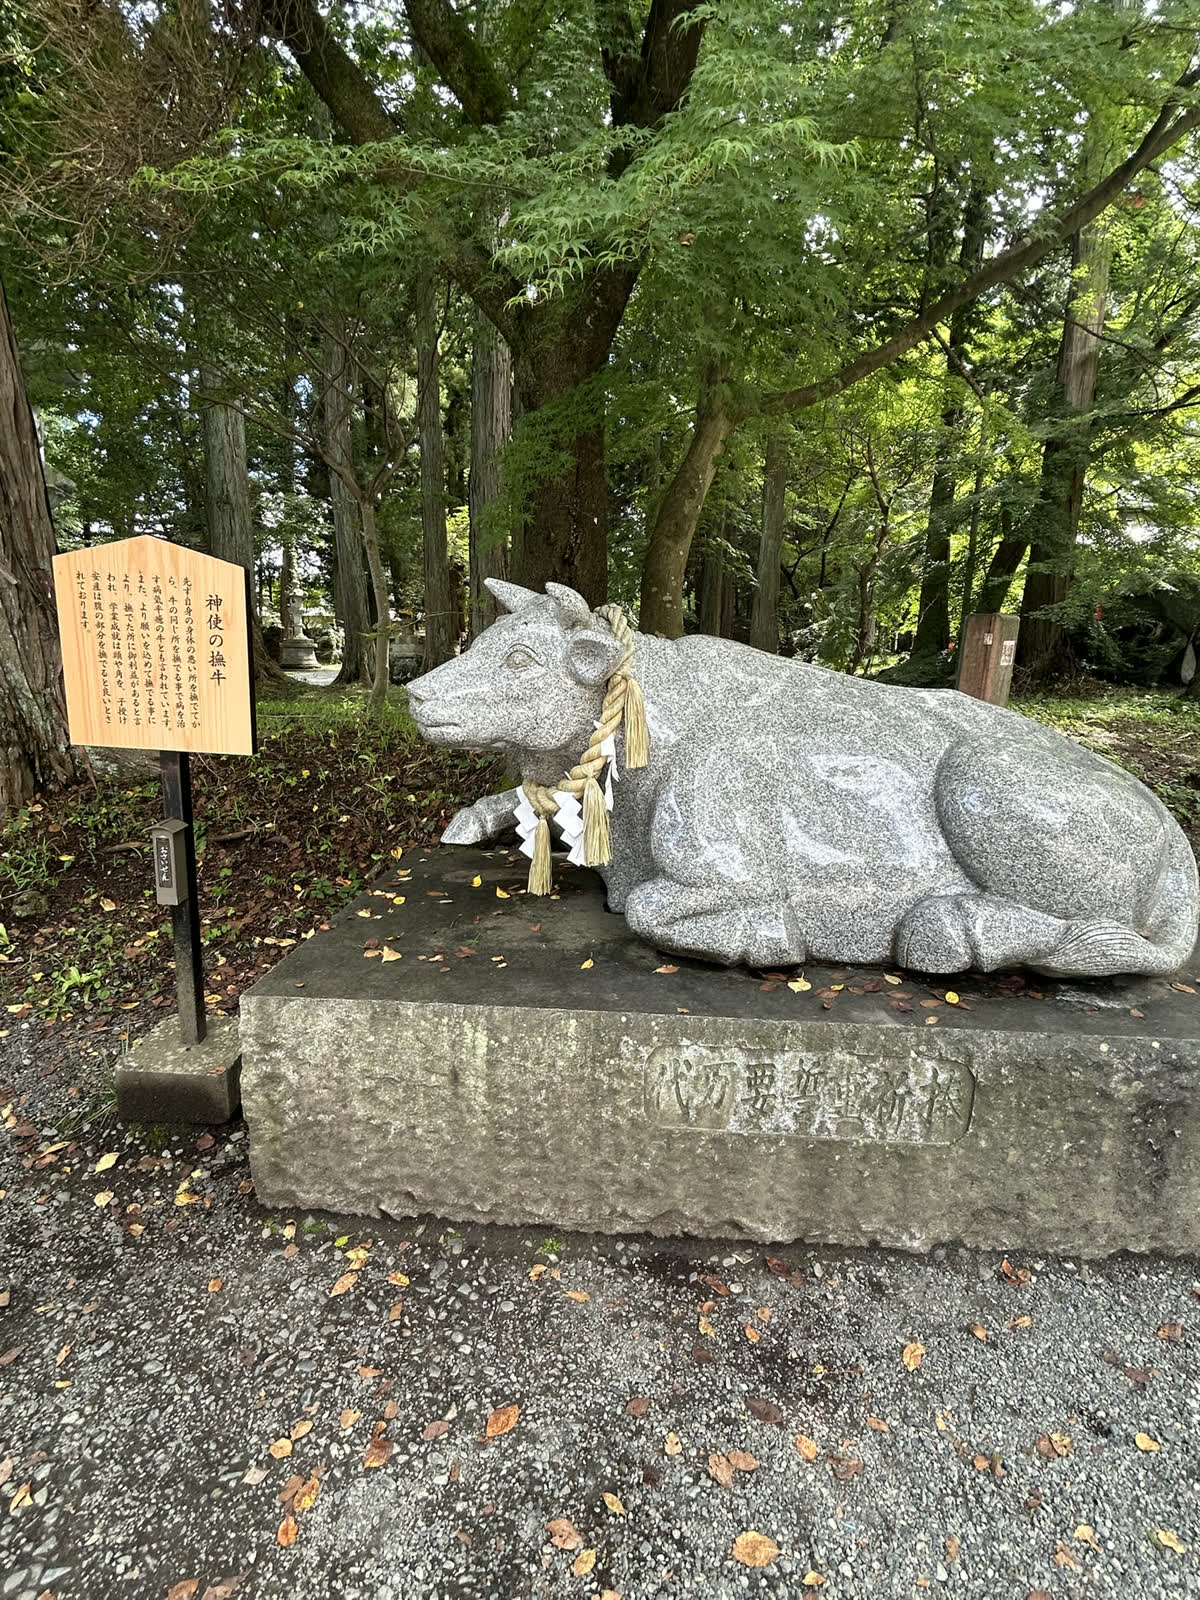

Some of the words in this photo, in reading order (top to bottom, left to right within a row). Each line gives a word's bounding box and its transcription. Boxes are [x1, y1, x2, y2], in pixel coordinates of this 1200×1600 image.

[76, 571, 91, 633] れております。
[205, 595, 227, 686] 神使の撫牛
[160, 846, 170, 881] おさいせん
